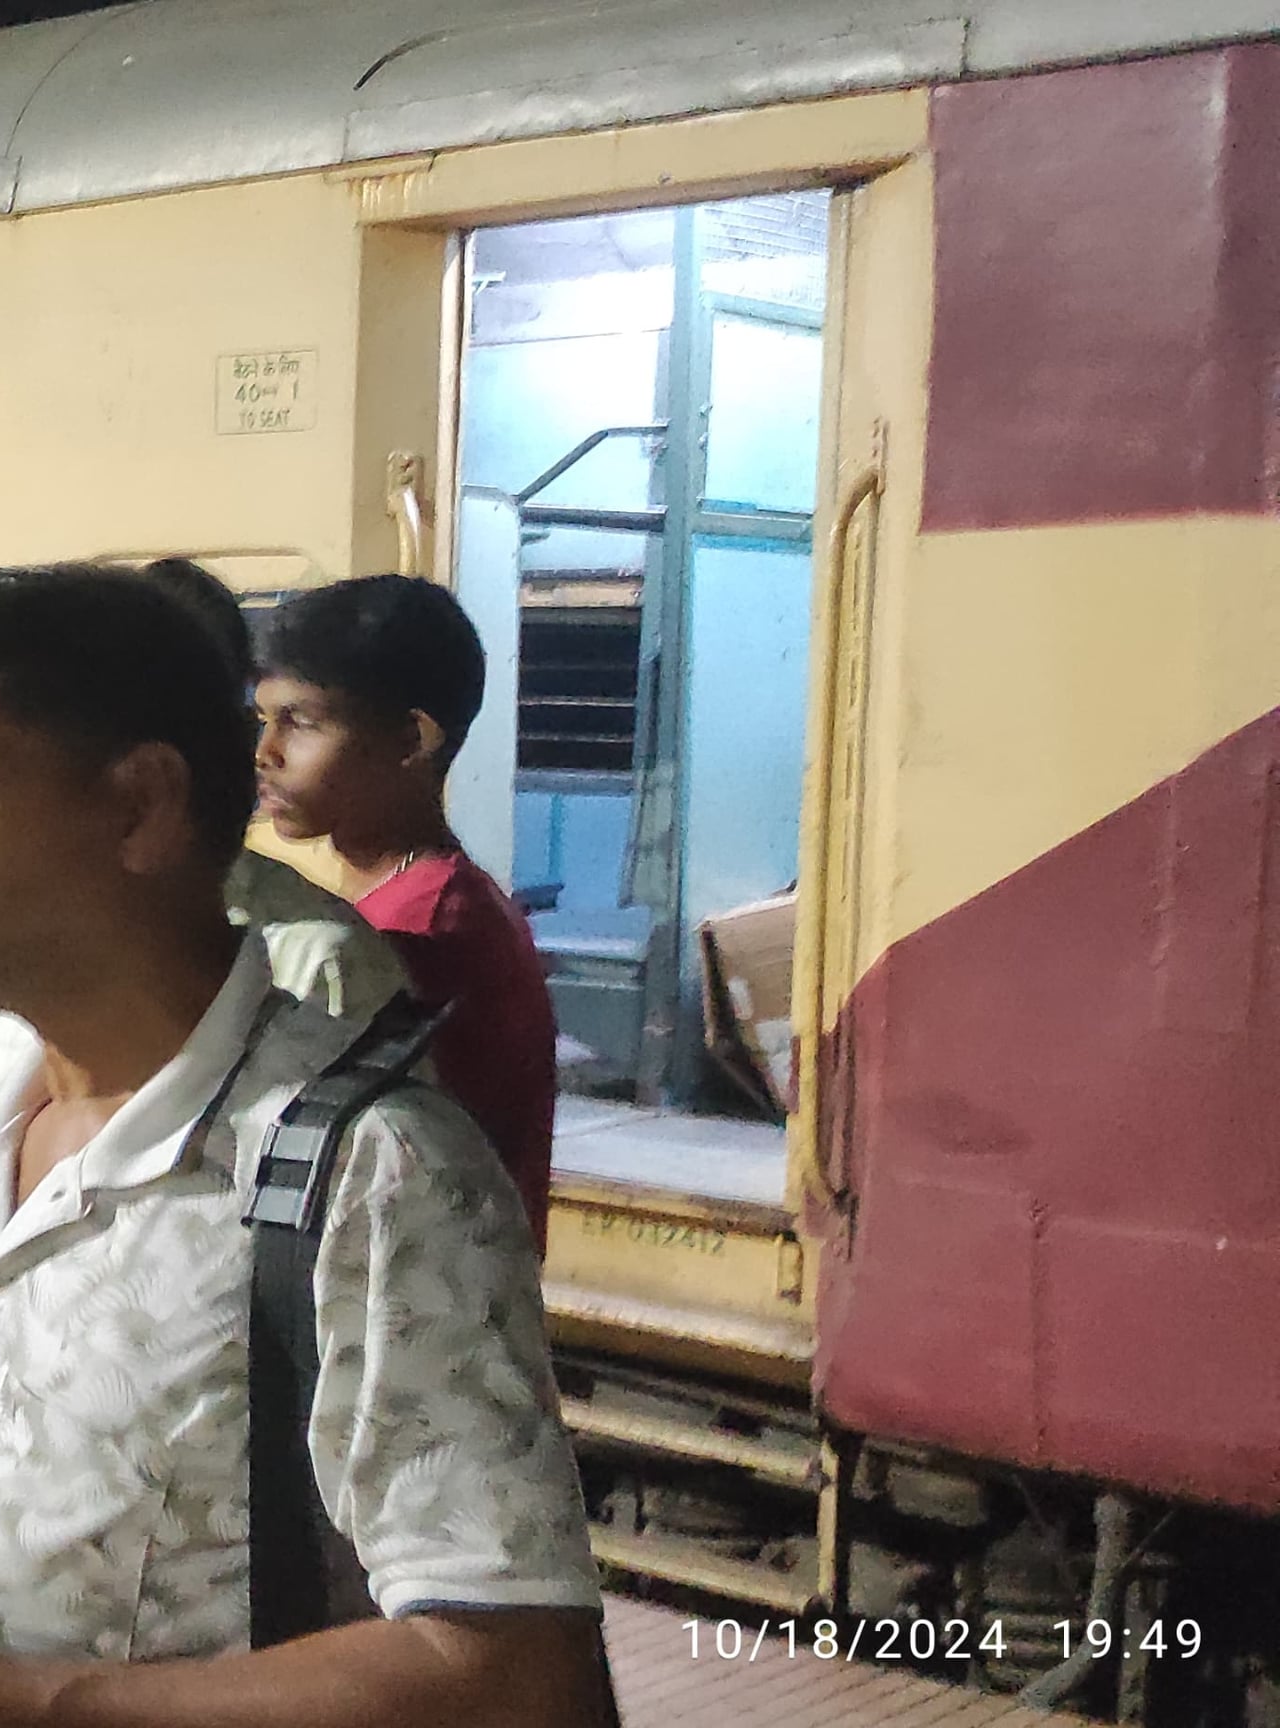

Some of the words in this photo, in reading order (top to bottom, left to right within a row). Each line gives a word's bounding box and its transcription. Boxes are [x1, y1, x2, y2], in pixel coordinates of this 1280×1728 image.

[234, 383, 261, 403] 40
[239, 409, 256, 429] TO
[260, 408, 291, 428] SEAT
